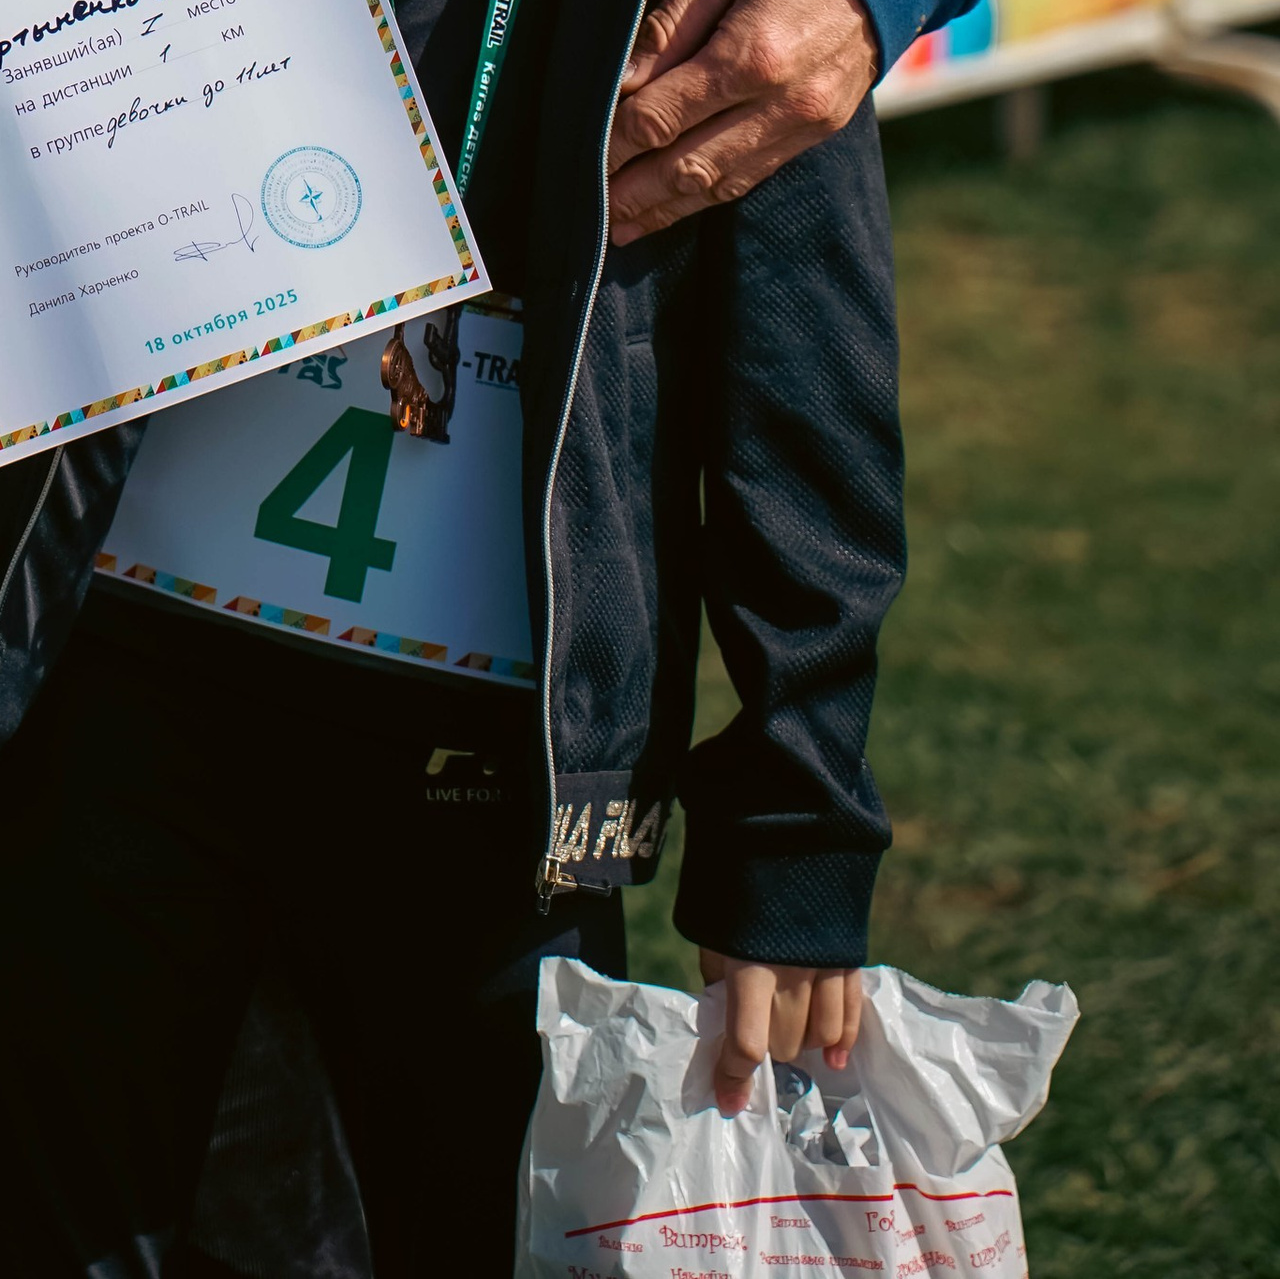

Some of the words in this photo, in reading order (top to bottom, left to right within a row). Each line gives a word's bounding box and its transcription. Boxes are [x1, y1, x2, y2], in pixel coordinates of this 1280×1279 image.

[2, 28, 124, 85] Занявший(ая)
[15, 99, 36, 116] на
[42, 64, 133, 109] дистанции
[158, 43, 172, 63] 1
[222, 24, 245, 43] км
[473, 60, 496, 122] Karras
[30, 144, 41, 160] в
[46, 123, 104, 155] группе
[202, 79, 225, 107] до
[458, 124, 480, 199] ДЕТСКИ
[14, 240, 102, 278] Руководитель
[104, 220, 155, 247] проекта
[157, 199, 210, 227] O-TRAIL
[28, 289, 76, 317] Данила
[78, 268, 140, 298] Харченко
[144, 337, 166, 355] 18
[172, 308, 249, 346] октября
[253, 288, 299, 317] 2025
[252, 405, 398, 604] 4
[426, 787, 462, 802] LIVE
